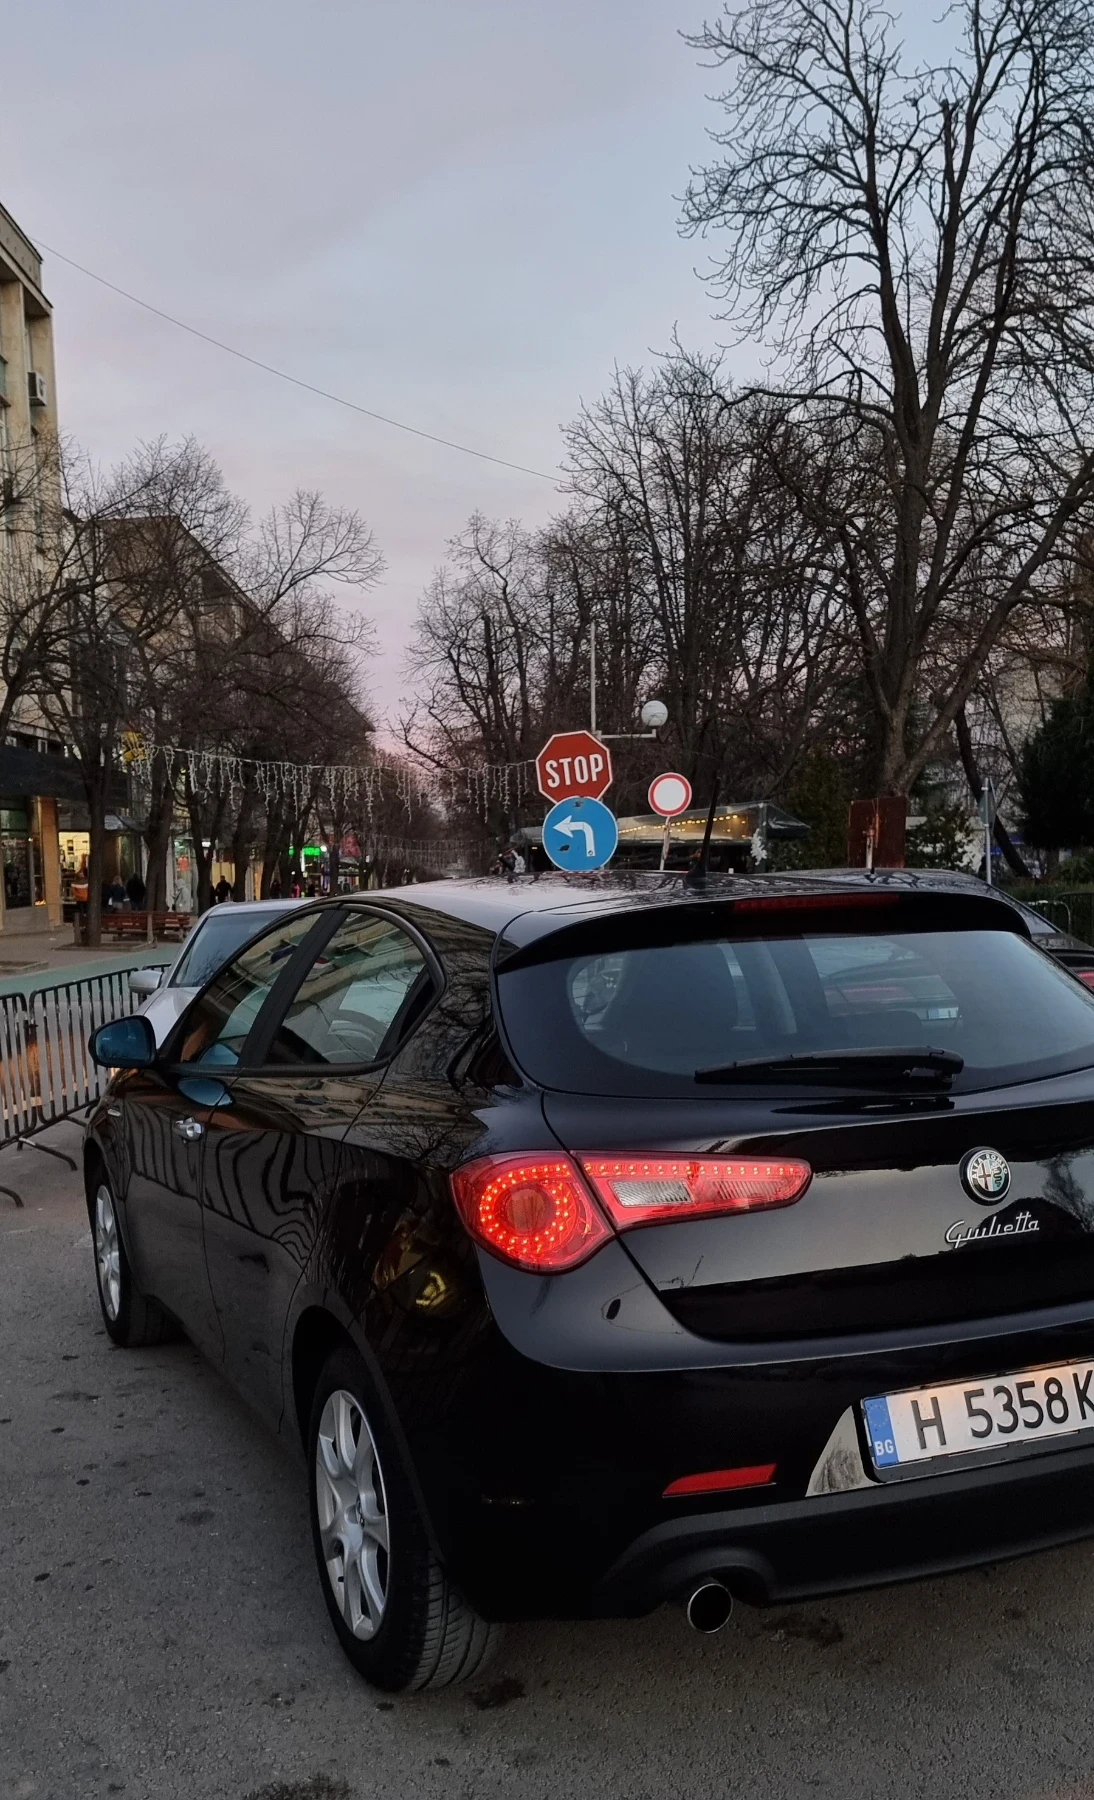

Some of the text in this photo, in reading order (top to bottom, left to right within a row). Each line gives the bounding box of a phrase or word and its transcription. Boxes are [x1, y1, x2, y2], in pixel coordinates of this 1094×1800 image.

[545, 753, 603, 788] STOP
[945, 1211, 1040, 1249] Giulietta
[910, 1396, 947, 1450] H
[874, 1439, 894, 1456] BG
